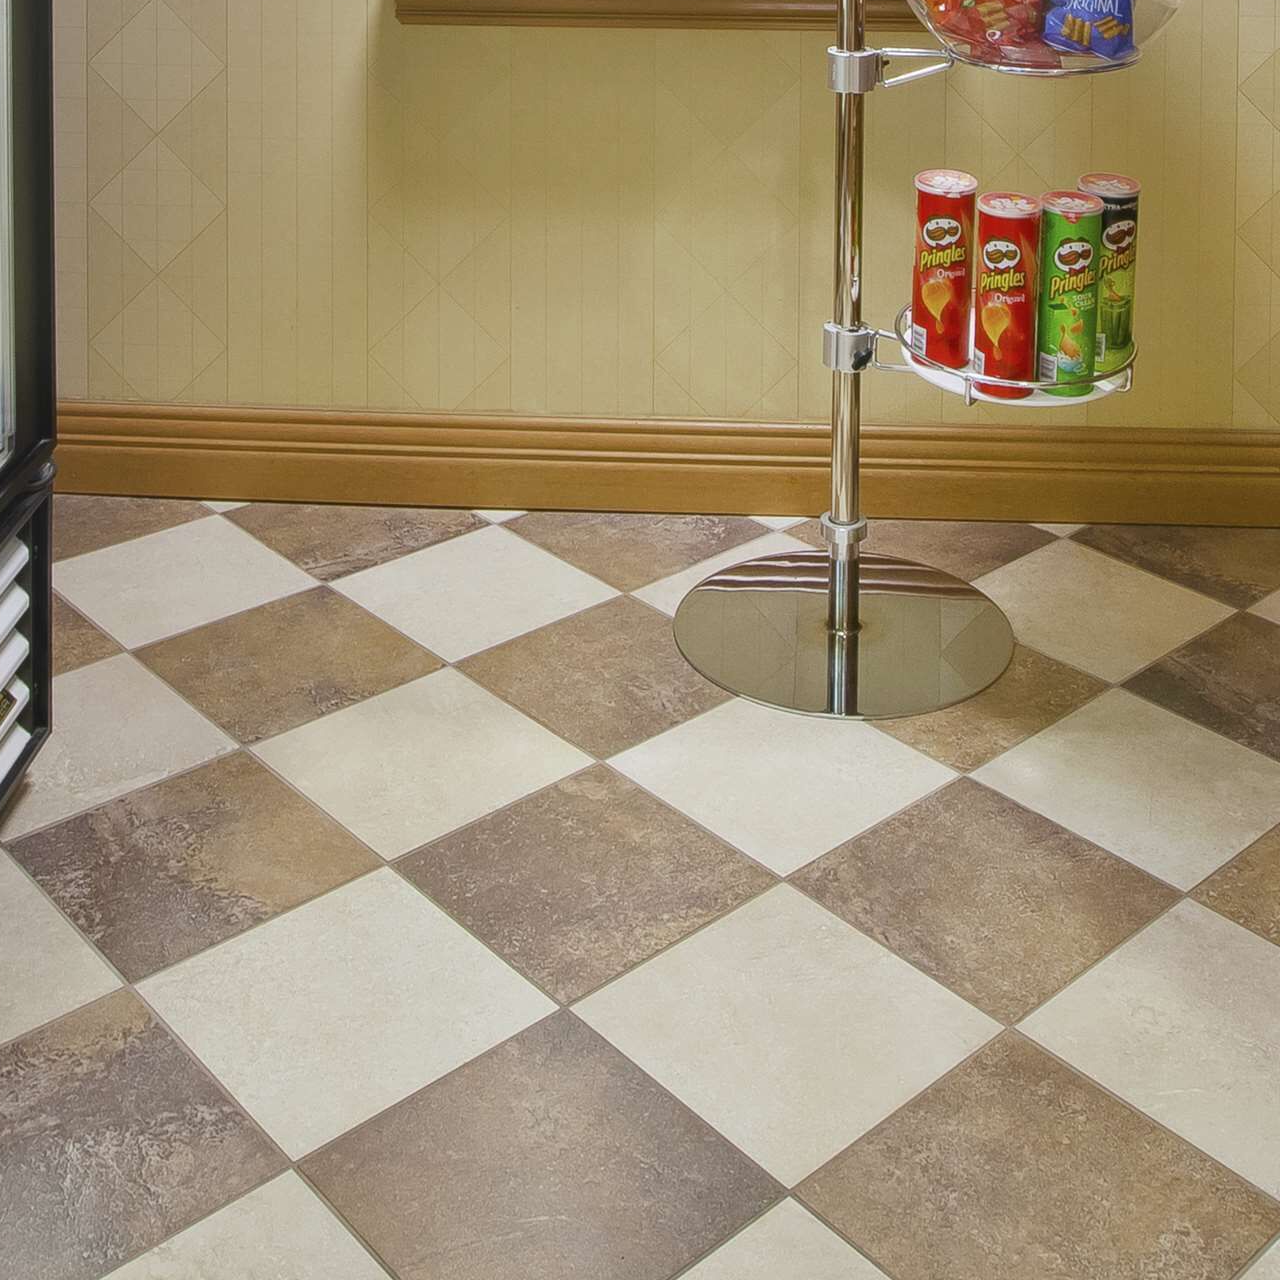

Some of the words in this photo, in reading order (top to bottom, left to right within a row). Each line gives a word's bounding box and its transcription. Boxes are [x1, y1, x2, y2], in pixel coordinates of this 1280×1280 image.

[920, 245, 966, 272] Pringles
[980, 269, 1025, 296] Pringles
[994, 292, 1026, 305] Original
